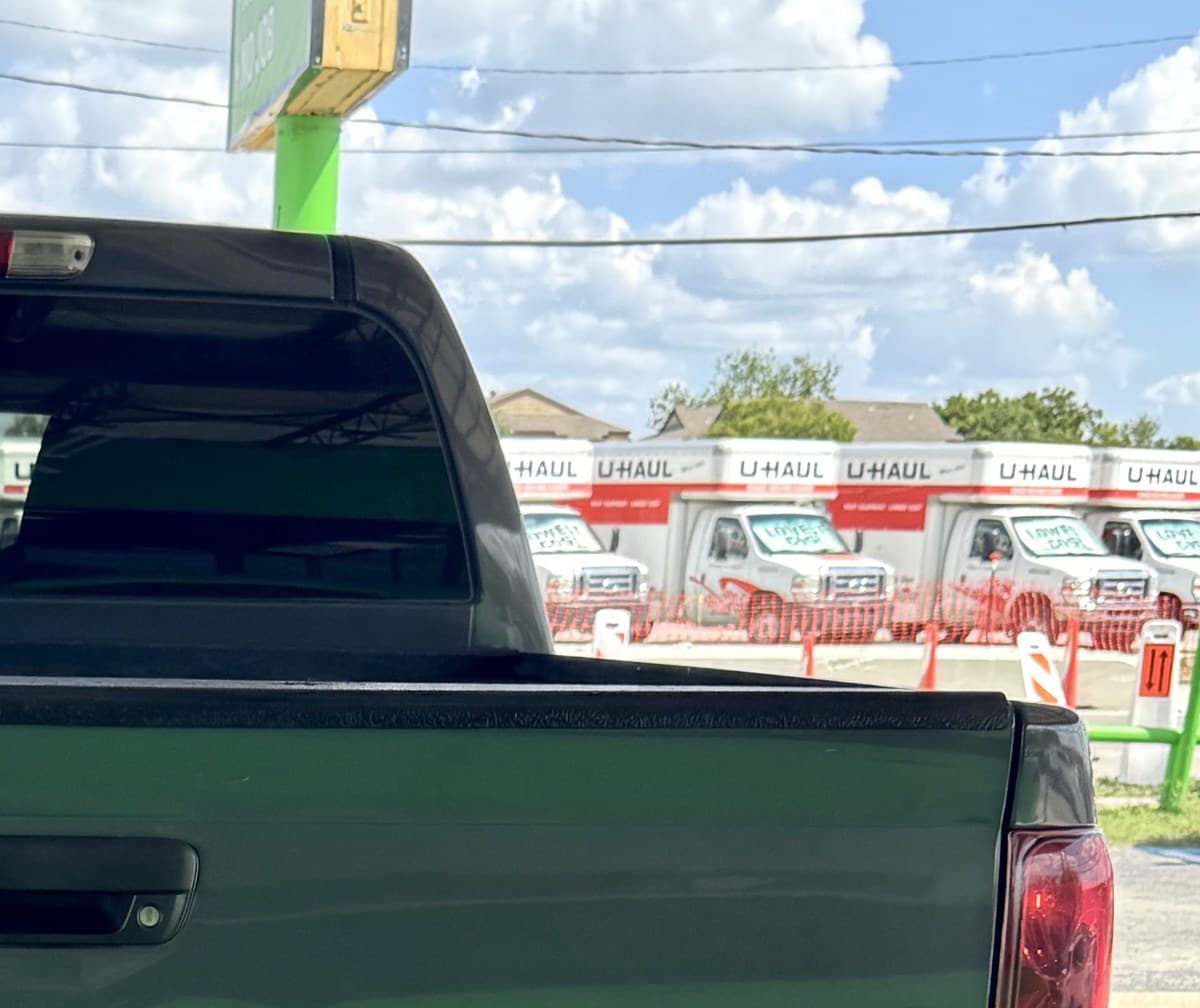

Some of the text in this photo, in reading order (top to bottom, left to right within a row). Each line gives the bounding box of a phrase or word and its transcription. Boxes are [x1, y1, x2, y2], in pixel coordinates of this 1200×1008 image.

[597, 460, 672, 478] U-HAUL
[740, 460, 824, 479] U-HAUL
[847, 462, 931, 480] U-HAUL
[1000, 463, 1078, 482] U-HAUL
[1128, 467, 1198, 486] U-HAUL
